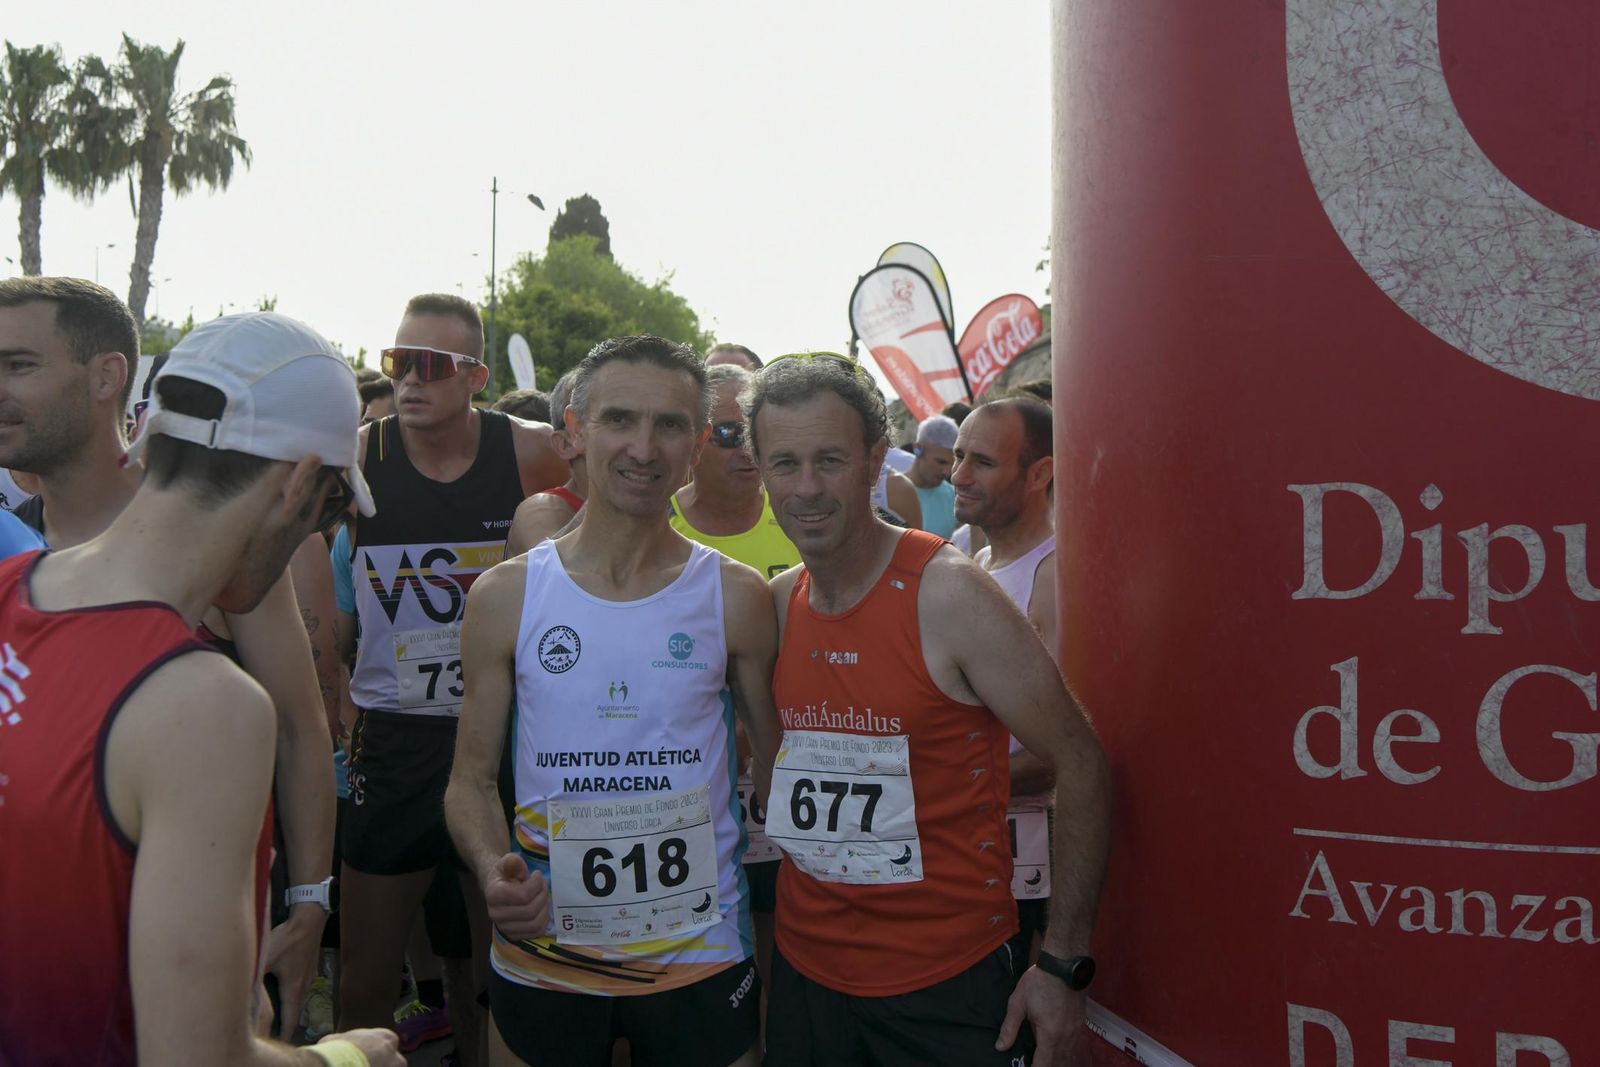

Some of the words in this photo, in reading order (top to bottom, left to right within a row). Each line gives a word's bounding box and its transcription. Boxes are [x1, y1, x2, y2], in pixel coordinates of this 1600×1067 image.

[669, 639, 693, 654] SIC
[651, 660, 709, 670] CONSULTORES
[596, 704, 640, 712] Ayuntamiento
[780, 700, 902, 733] WadiÁndalus
[1293, 655, 1442, 785] de
[1475, 664, 1600, 792] G
[536, 751, 620, 768] JUVENTUD
[625, 746, 702, 767] ATLÉTICA
[842, 740, 850, 752] DE
[850, 740, 870, 754] FONDO
[872, 740, 893, 754] 2023
[563, 776, 672, 793] MARACENA
[593, 805, 613, 818] GRAN
[615, 803, 642, 817] PREMIO
[644, 802, 653, 813] DE
[656, 799, 679, 812] FONDO
[680, 792, 699, 808] 2023
[790, 778, 883, 832] 677
[604, 820, 638, 833] UNIVERSO
[640, 818, 662, 830] LORCA
[582, 837, 690, 898] 618
[1288, 849, 1600, 945] Avanza
